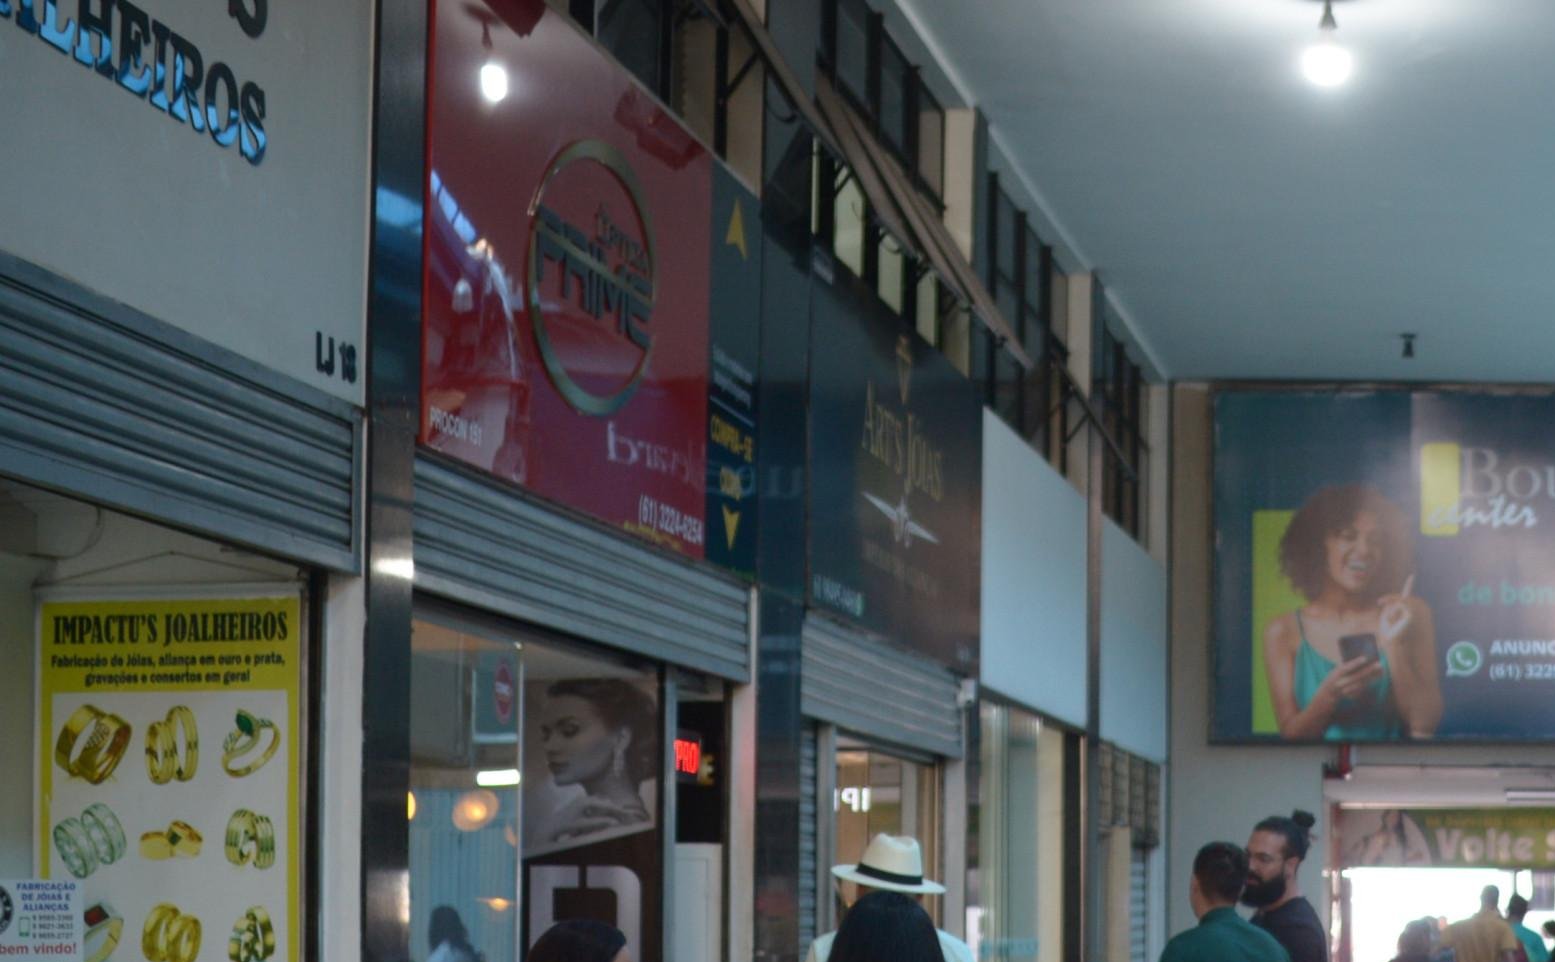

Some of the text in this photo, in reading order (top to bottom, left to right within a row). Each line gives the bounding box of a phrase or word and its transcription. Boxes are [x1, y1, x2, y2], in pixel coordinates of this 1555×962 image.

[537, 204, 651, 350] PRIME
[1457, 580, 1493, 607] de
[53, 610, 288, 647] IMPACTU'S JOALHEIROS
[51, 653, 108, 672] Fabricação
[111, 654, 124, 668] de
[200, 655, 216, 667] em
[218, 654, 242, 666] ouro
[245, 655, 251, 665] e
[1489, 662, 1522, 681] (61)
[141, 674, 148, 684] e
[150, 670, 203, 685] consertos
[205, 672, 221, 683] em
[223, 669, 250, 686] geral
[1435, 827, 1535, 864] Volte
[16, 880, 76, 893] FABRICAÇÃO
[21, 893, 34, 901] DE
[36, 891, 63, 901] JÓIAS
[22, 903, 70, 914] ALIANÇAS
[33, 942, 77, 955] vindo!
